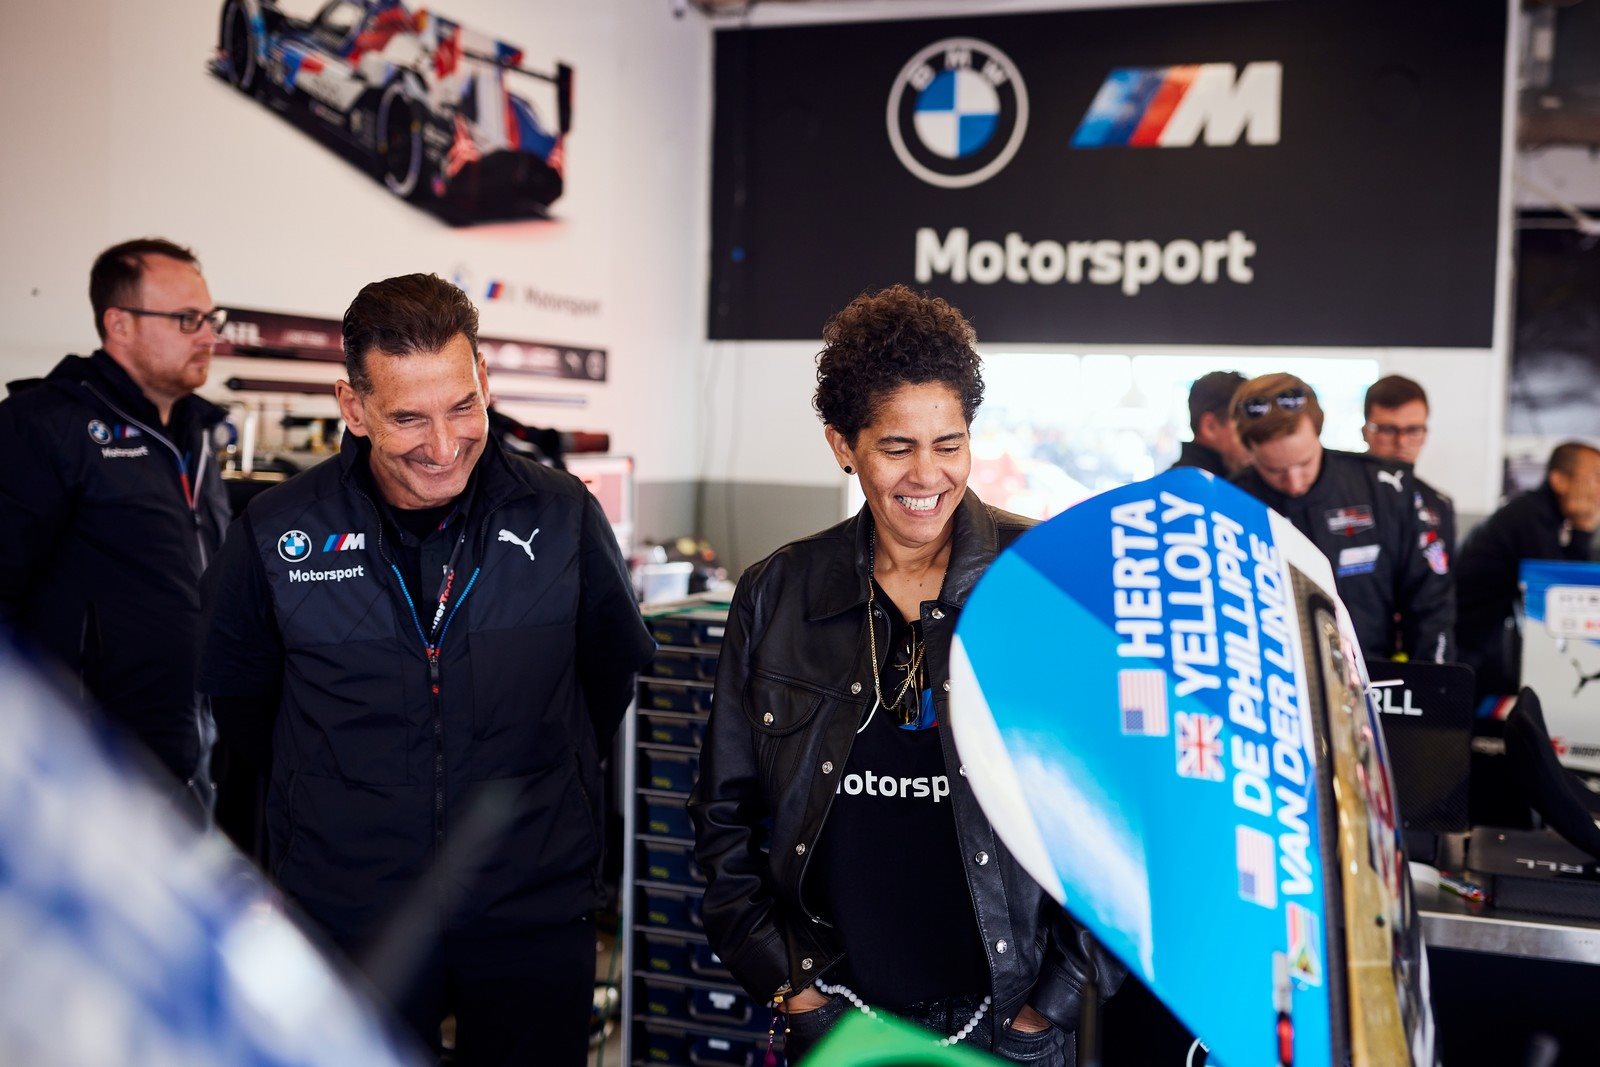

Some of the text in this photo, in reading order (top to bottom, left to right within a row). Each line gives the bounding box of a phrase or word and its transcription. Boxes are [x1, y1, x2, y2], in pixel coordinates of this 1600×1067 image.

[911, 48, 1009, 92] BMW
[1156, 60, 1283, 147] M
[915, 227, 1256, 296] Motorsport
[288, 565, 364, 582] Motorsport
[340, 533, 365, 551] M
[1111, 499, 1165, 659] HERTA
[1160, 491, 1221, 697] YELLOLY
[1211, 511, 1273, 817] DE PHILLIPPI
[1249, 533, 1314, 895] VAN DER LINDE
[836, 770, 950, 802] otorsp
